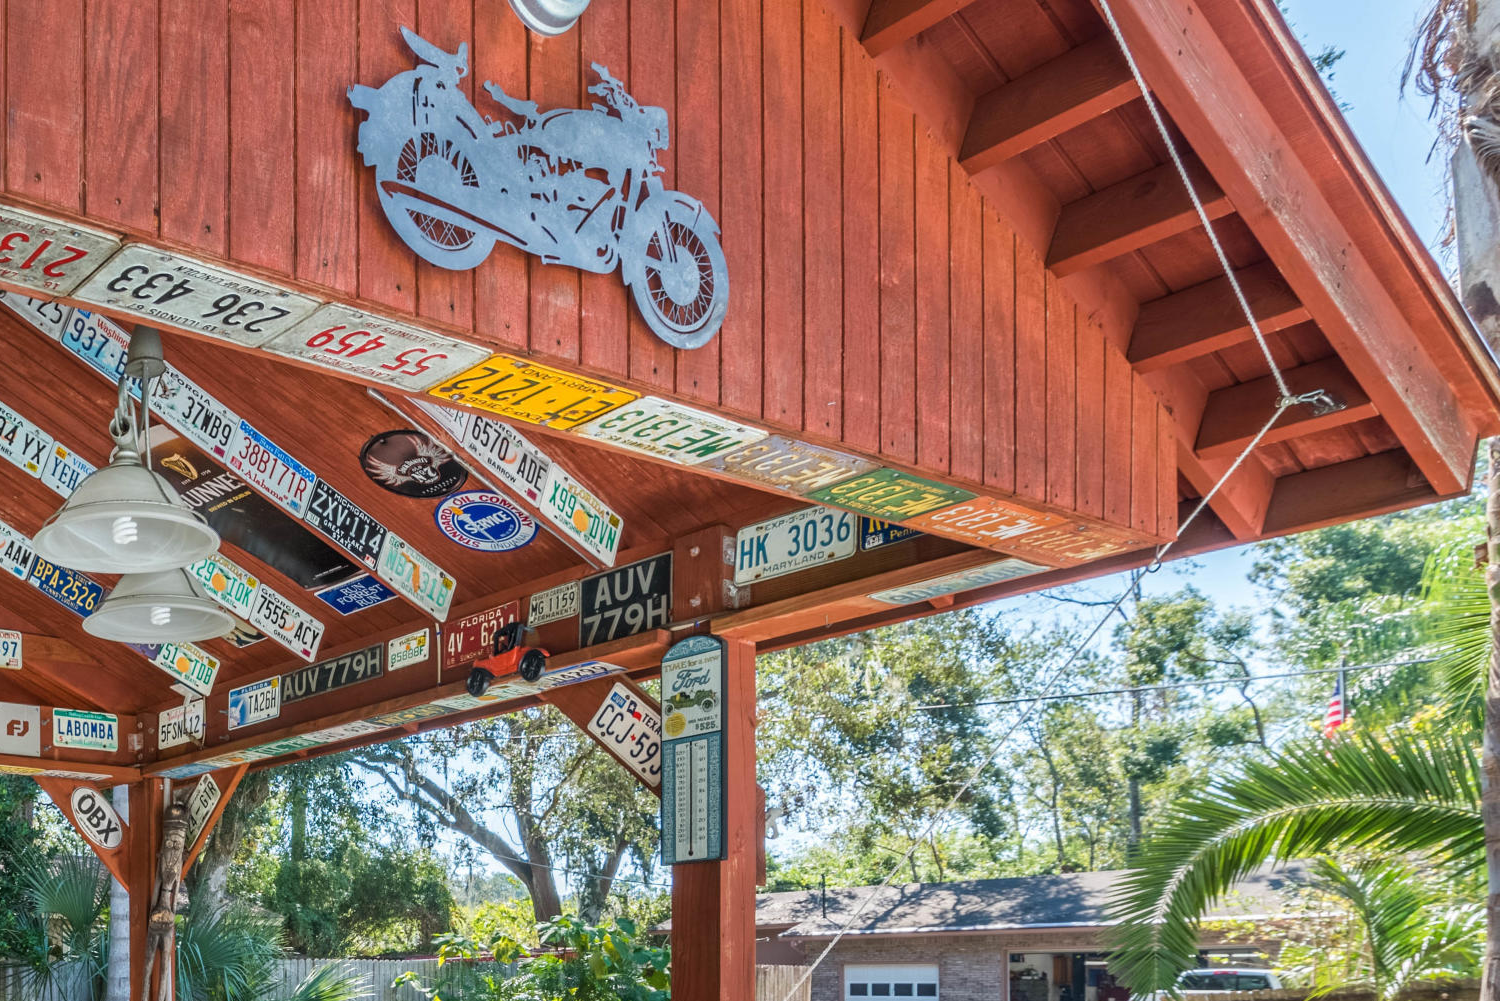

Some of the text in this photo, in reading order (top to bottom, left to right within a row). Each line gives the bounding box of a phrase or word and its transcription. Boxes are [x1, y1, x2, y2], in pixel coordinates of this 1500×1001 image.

[106, 264, 291, 333] 236 433
[148, 307, 200, 328] ILLINOIS
[305, 325, 448, 377] 55 459
[450, 366, 553, 407] 1212
[521, 367, 602, 395] MARYLAND
[181, 395, 233, 447] 37WB9
[598, 409, 743, 458] ME 1313
[22, 433, 47, 465] YX
[470, 414, 548, 493] 6570 ADE
[238, 436, 308, 502] 38B171R
[486, 457, 518, 485] BARROW
[333, 492, 371, 524] MICHIGAN
[438, 493, 534, 548] STANDARD OIL COMPANY
[463, 510, 514, 535] SERVICE
[3, 539, 33, 569] AAM
[739, 511, 850, 572] HK 3036
[762, 550, 826, 576] MARYLAND
[41, 583, 80, 611] PENNSYLVANIA
[261, 587, 301, 619] GEORGIA
[336, 583, 384, 606] FORREST
[341, 581, 366, 596] RUN
[358, 593, 382, 608] RUN
[583, 560, 668, 647] AUV 779H
[256, 593, 320, 650] 7555 ACY
[460, 608, 502, 629] FLORIDA
[281, 647, 381, 702] AUV 779H
[664, 661, 687, 673] TIME
[671, 667, 711, 692] Ford
[248, 687, 277, 716] TA26H
[56, 717, 115, 742] LABOMBA
[76, 793, 120, 846] OBX
